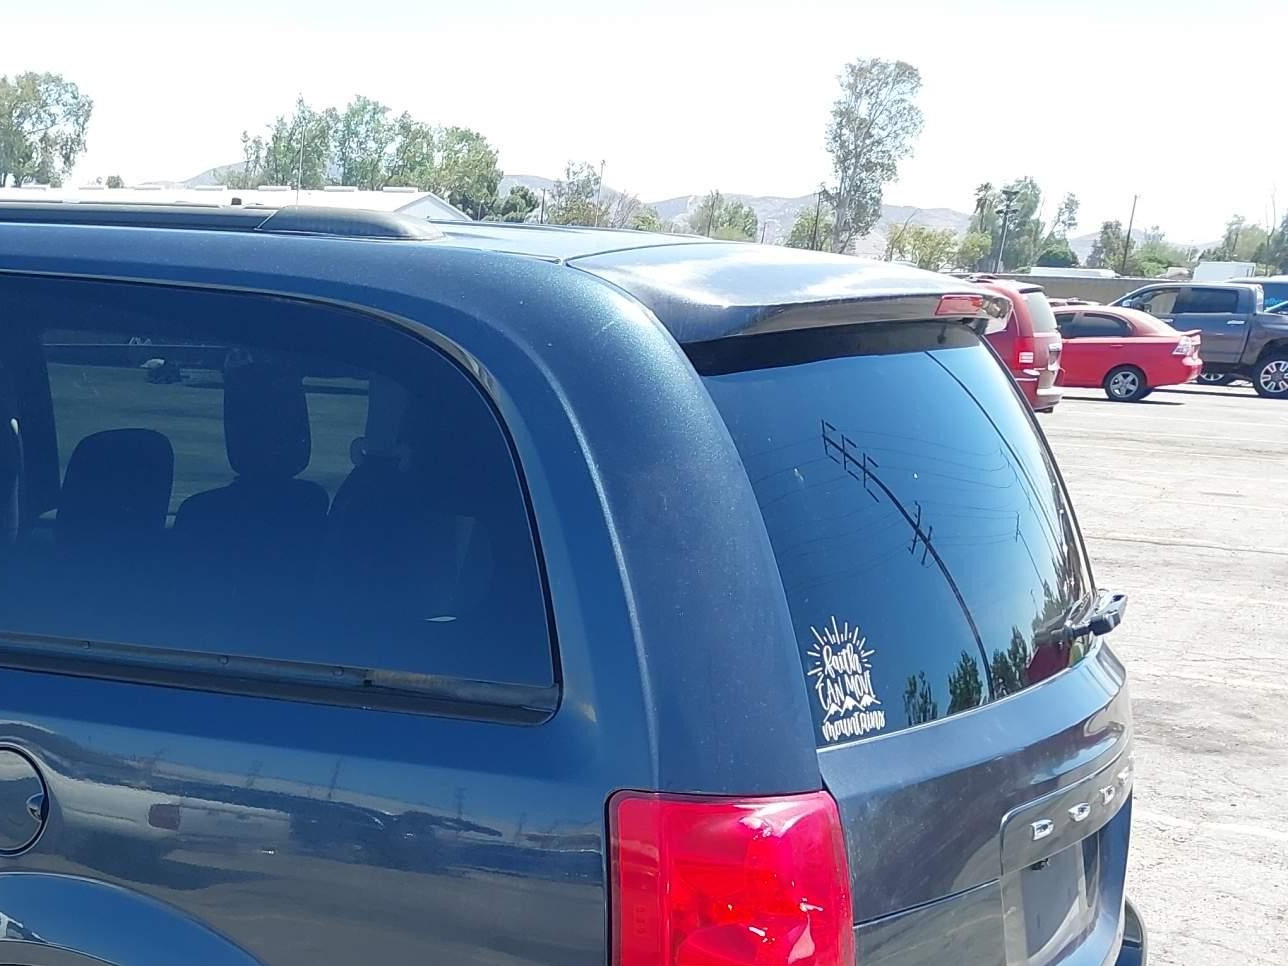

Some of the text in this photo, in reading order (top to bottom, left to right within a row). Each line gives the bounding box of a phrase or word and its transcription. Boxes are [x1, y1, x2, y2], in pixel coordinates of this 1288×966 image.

[822, 642, 863, 679] faith
[818, 676, 846, 711] CAN
[822, 710, 886, 742] mountains
